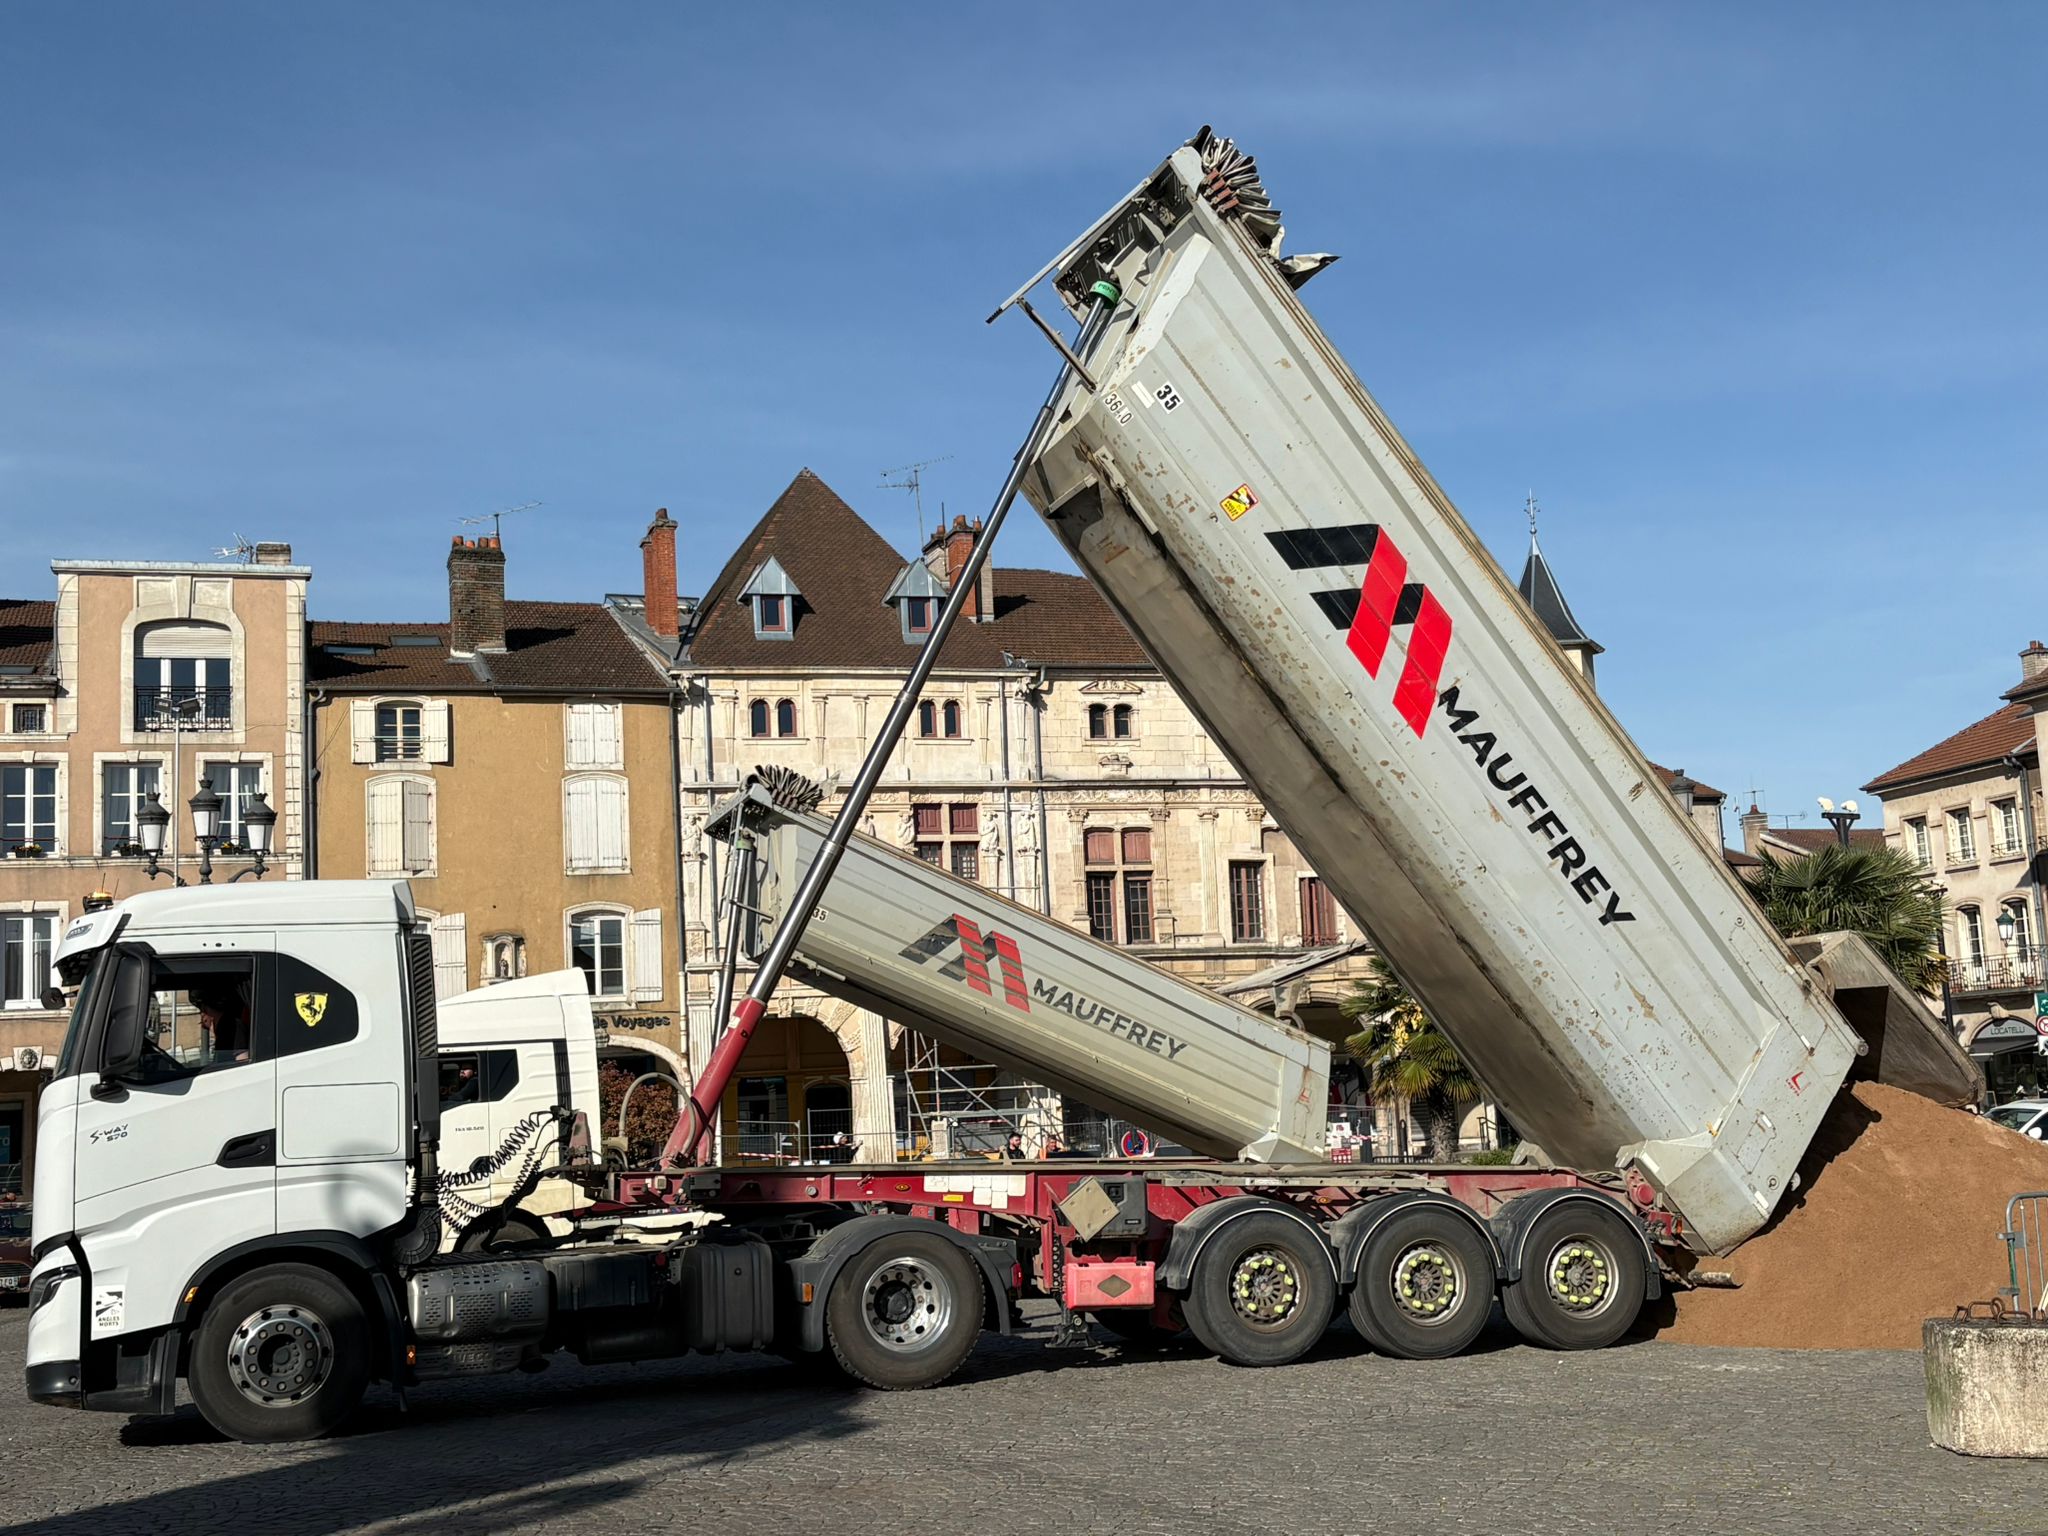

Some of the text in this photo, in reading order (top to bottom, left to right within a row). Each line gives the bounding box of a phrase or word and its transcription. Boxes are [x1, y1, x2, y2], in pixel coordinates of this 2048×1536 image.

[1156, 384, 1181, 411] 35
[1437, 685, 1637, 927] MAUFFREY
[812, 908, 827, 921] 35
[611, 1015, 671, 1030] Voyages
[1033, 978, 1188, 1060] MAUFFREY
[1990, 1026, 2026, 1036] LOCATELLI
[89, 1123, 129, 1145] S-WAY
